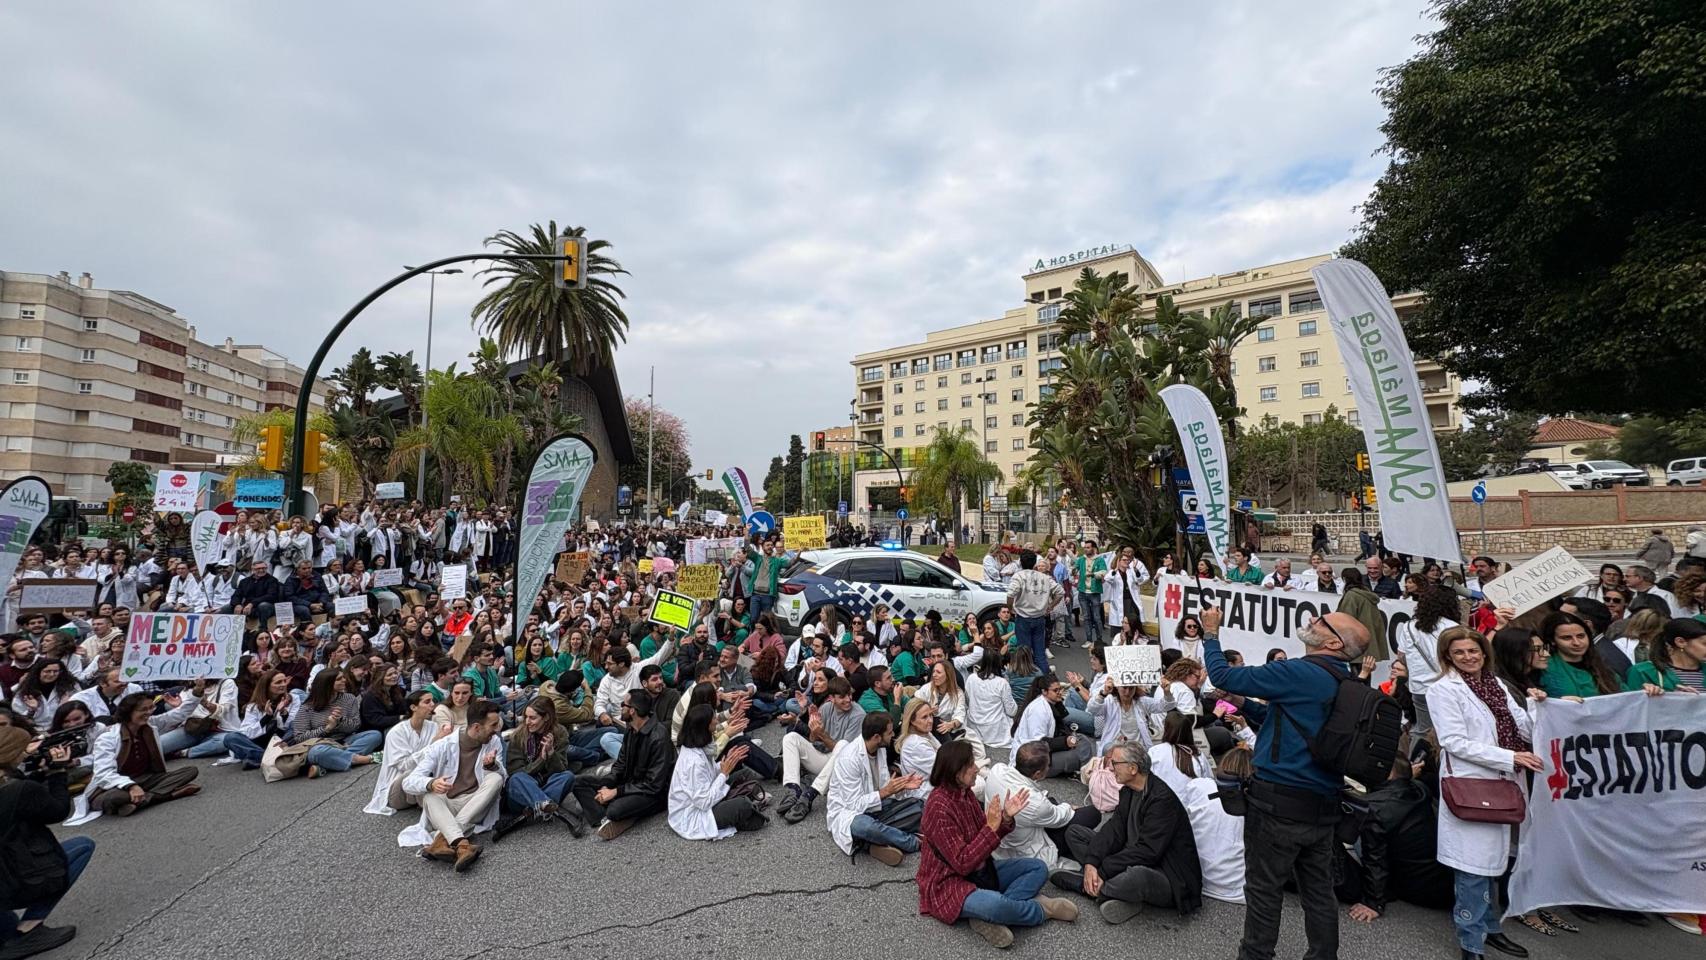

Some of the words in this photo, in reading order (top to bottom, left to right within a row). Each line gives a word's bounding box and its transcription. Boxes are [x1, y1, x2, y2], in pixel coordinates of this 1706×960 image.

[1050, 243, 1118, 266] HOSPITAL
[543, 447, 591, 469] SMA
[10, 487, 46, 508] SMA
[237, 495, 284, 503] FONENDOS
[195, 519, 217, 553] SMA
[520, 529, 551, 583] SINDICATO
[1513, 575, 1528, 590] A
[1526, 551, 1573, 580] NOSOTROS
[1532, 577, 1558, 596] NOS
[149, 643, 177, 655] NO
[183, 643, 216, 658] MATA
